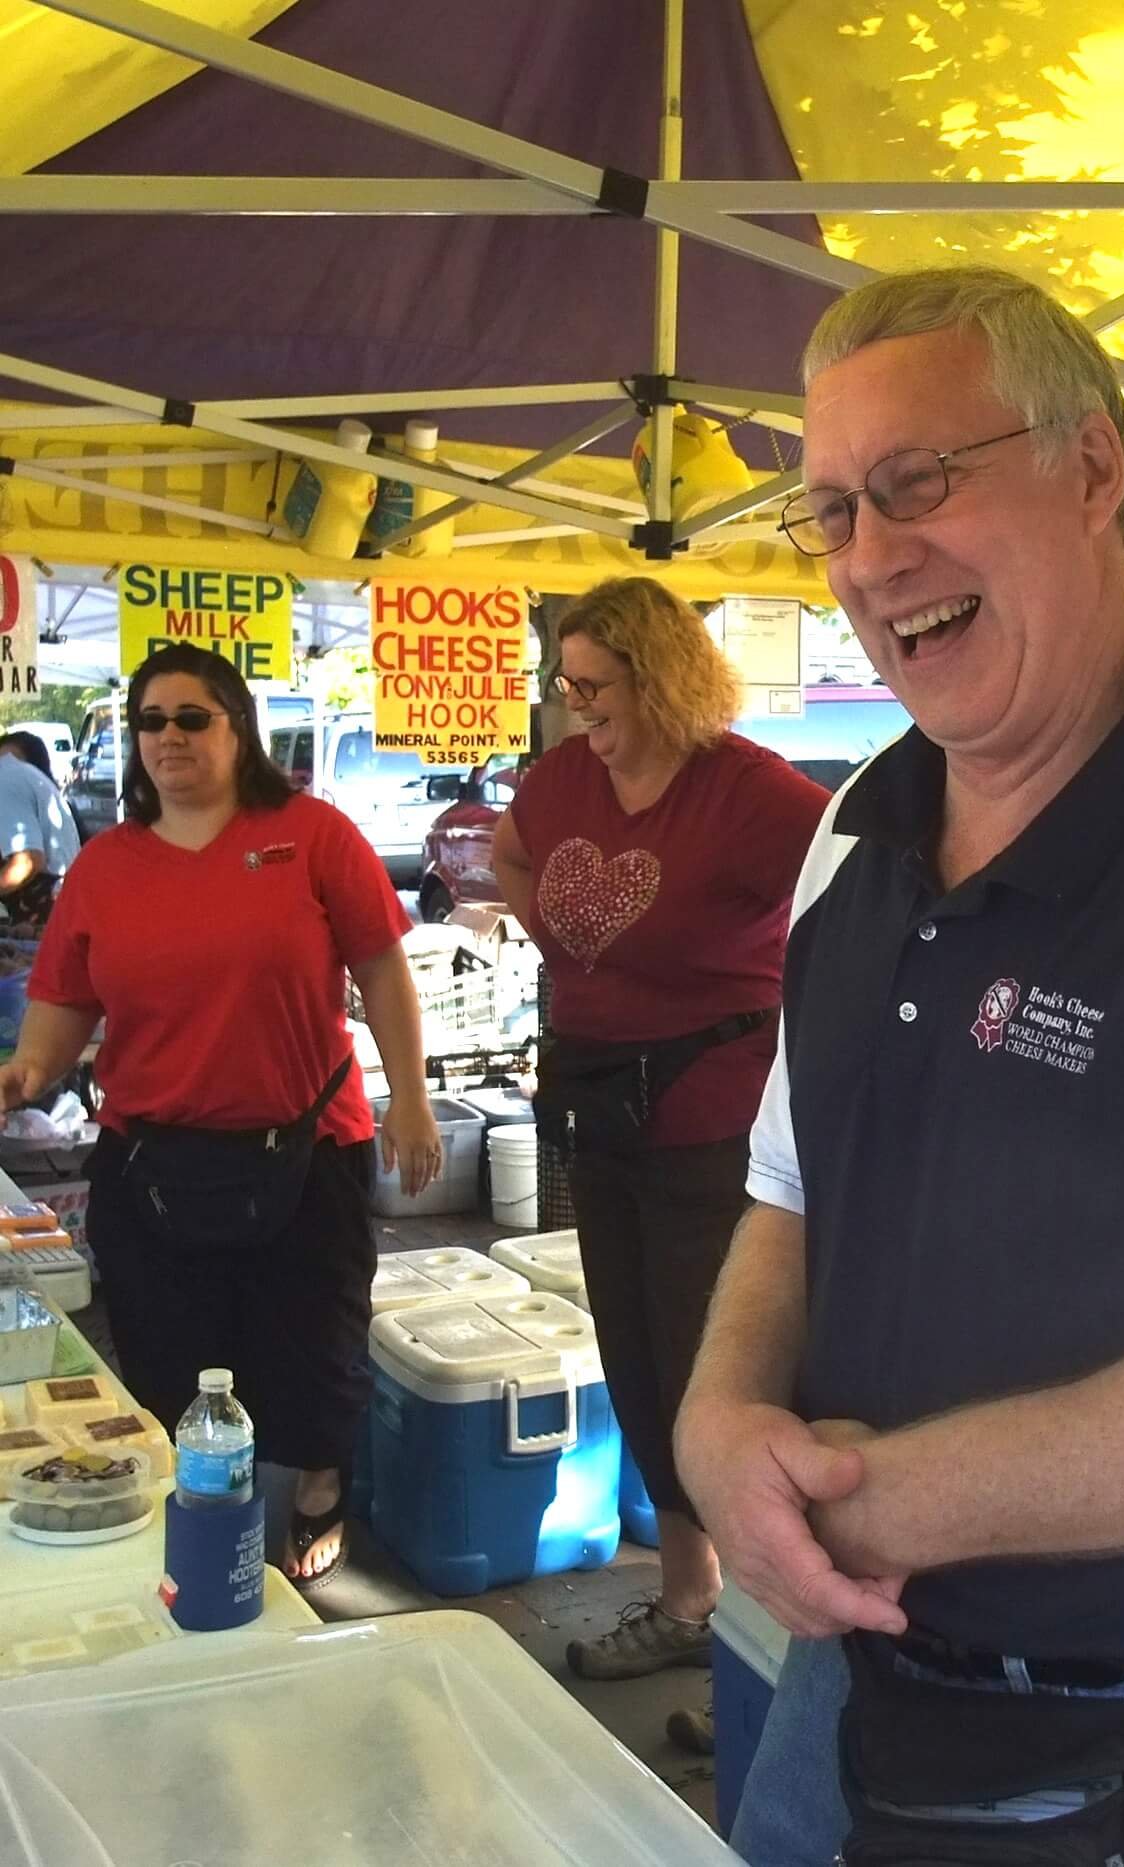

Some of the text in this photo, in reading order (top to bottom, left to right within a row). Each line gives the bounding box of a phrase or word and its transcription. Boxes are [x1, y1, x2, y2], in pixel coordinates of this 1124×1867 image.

[125, 564, 284, 613] SHEEP
[375, 585, 521, 629] HOOK'S
[166, 610, 250, 640] MILK
[373, 631, 521, 675] CHEESE
[453, 674, 527, 701] JULIE
[407, 702, 499, 729] HOOK
[376, 733, 441, 746] MINERAL
[508, 734, 527, 746] WI
[427, 751, 479, 764] 53565
[1007, 1022, 1044, 1044] WORLD
